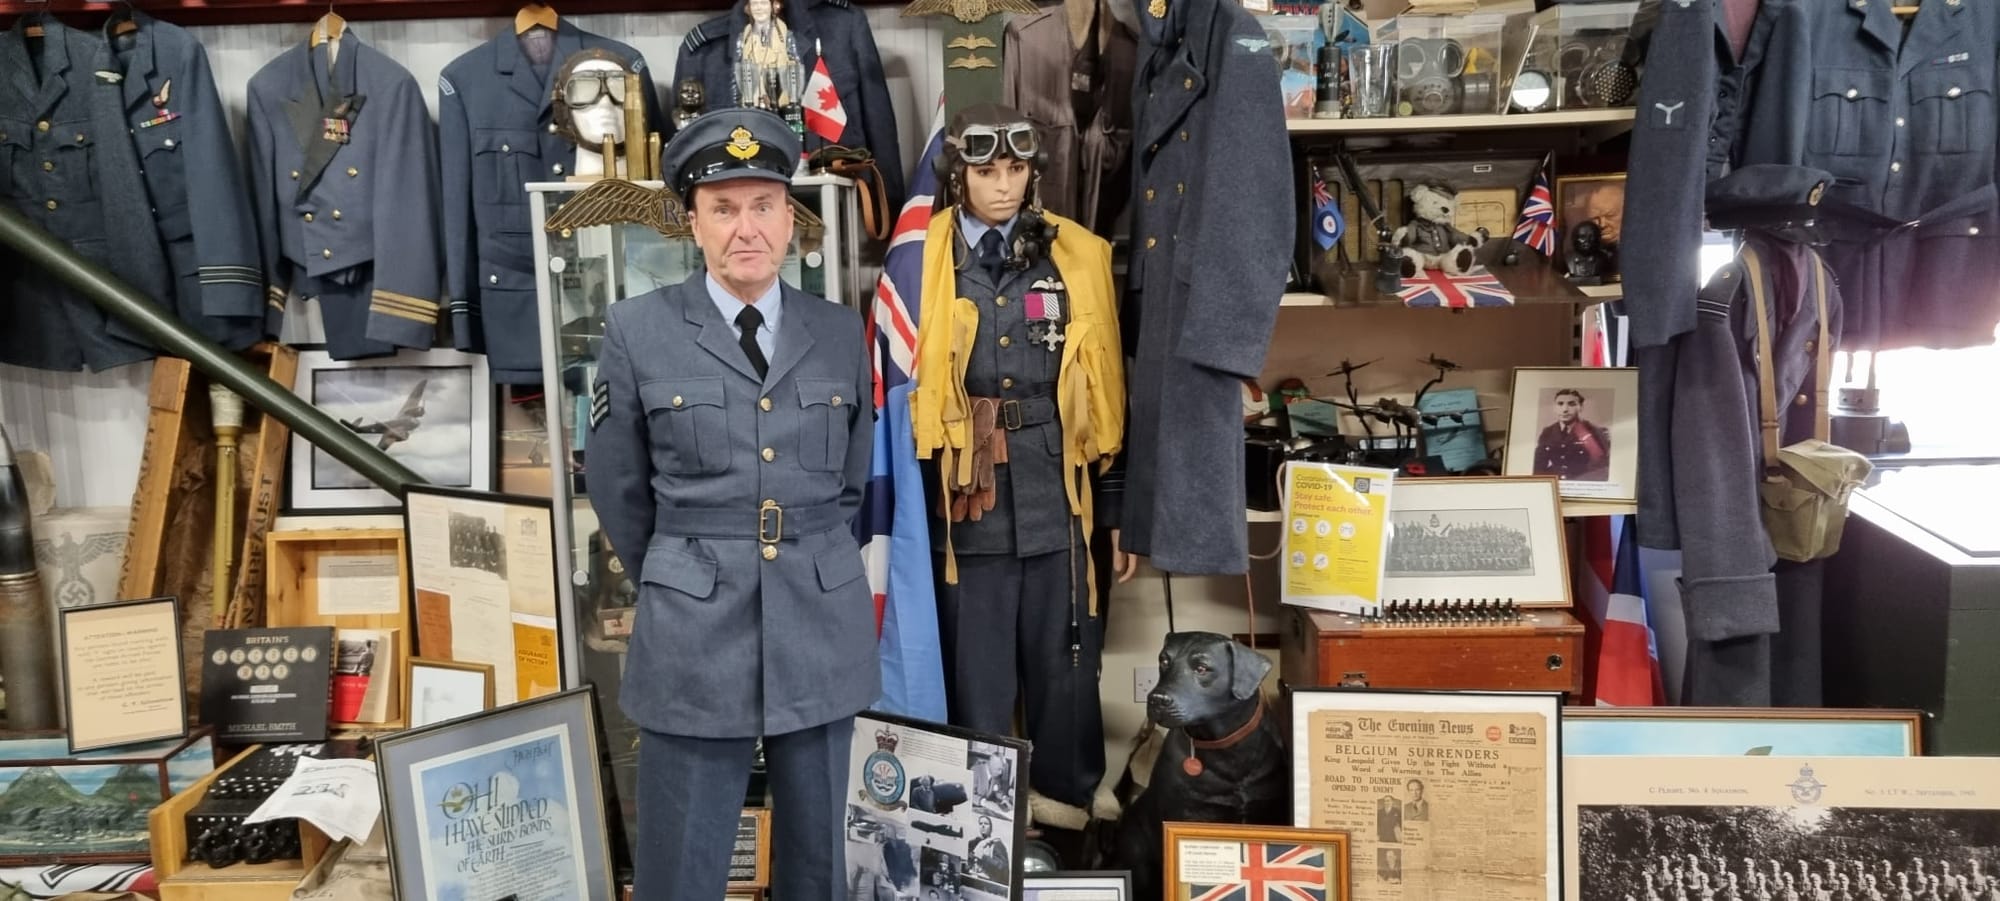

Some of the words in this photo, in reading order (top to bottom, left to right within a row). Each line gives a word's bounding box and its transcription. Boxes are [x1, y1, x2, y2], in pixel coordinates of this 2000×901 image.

[663, 199, 690, 228] RA
[1296, 482, 1333, 491] COVID-19
[1294, 492, 1313, 501] Stay
[117, 423, 154, 600] ANZERFAUST
[1294, 502, 1324, 511] Protect
[1326, 504, 1346, 512] each
[241, 474, 273, 624] NZERFAUST
[246, 636, 289, 644] BRITAIN'S
[228, 724, 267, 732] MICHAEL
[269, 722, 297, 731] SMITH
[1358, 717, 1382, 733] The
[1387, 718, 1435, 735] Evening
[1439, 719, 1474, 734] News
[1335, 744, 1398, 757] BELGIUM
[1407, 746, 1500, 760] SURRENDERS
[1324, 756, 1341, 765] King
[1346, 757, 1375, 766] Leopold
[1382, 758, 1401, 766] Gives
[1406, 758, 1418, 767] Up
[1424, 759, 1435, 767] the
[1441, 760, 1460, 769] Fight
[1467, 761, 1497, 769] Without
[1391, 767, 1422, 776] Warning
[1441, 768, 1456, 776] The
[1461, 769, 1482, 777] Allies
[1324, 775, 1345, 783] ROAD
[1351, 775, 1362, 784] TO
[1369, 776, 1401, 785] DUNKIRK
[1331, 784, 1356, 792] OPENED
[1360, 785, 1369, 793] TO
[1372, 785, 1394, 793] ENEMY
[445, 825, 449, 846] I
[453, 815, 491, 844] HAVE
[494, 798, 548, 831] SLIPPED
[466, 836, 483, 855] THE
[519, 817, 553, 838] BONDS
[457, 856, 469, 873] OF
[471, 847, 505, 872] EARTH
